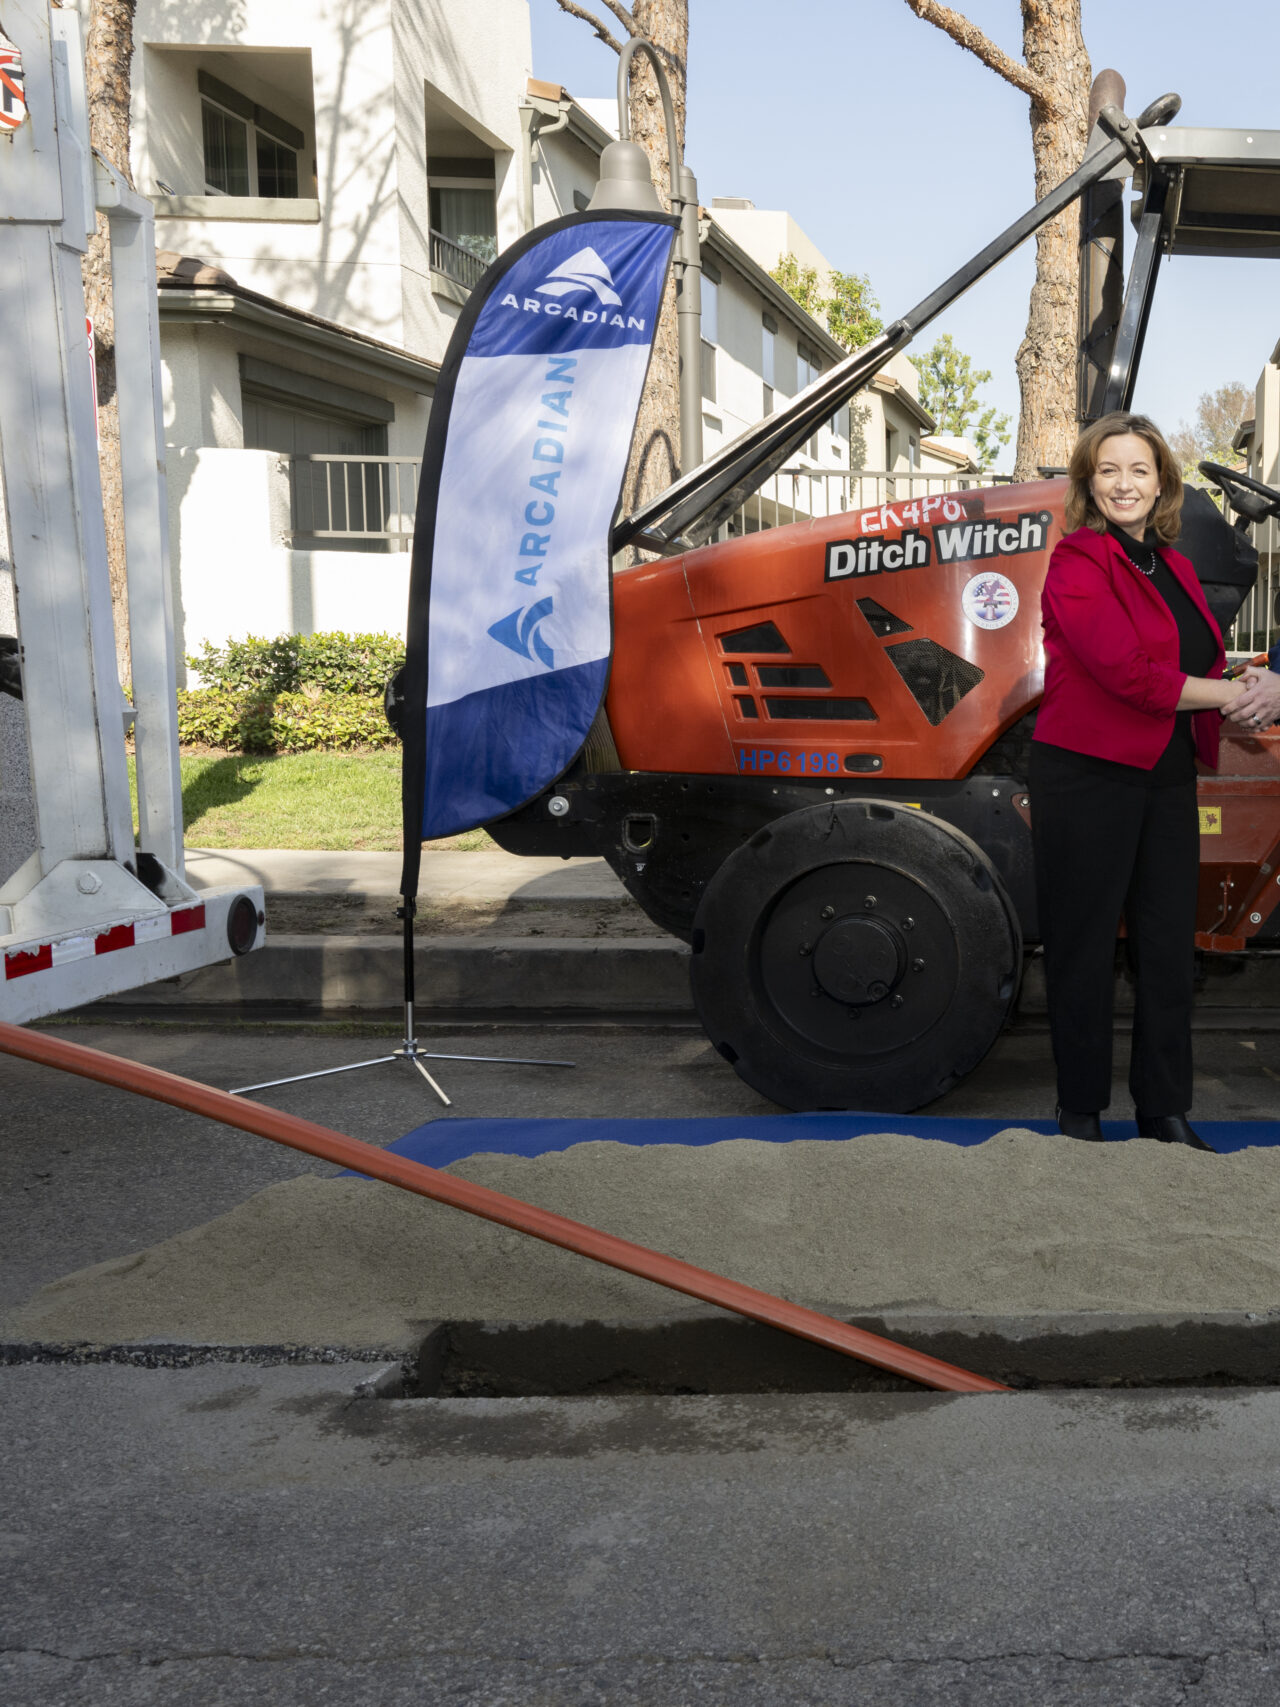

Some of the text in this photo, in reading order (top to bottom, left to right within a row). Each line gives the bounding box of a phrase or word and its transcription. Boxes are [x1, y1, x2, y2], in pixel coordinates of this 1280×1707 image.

[501, 293, 646, 332] ARCADIAN
[514, 357, 578, 587] ARCADIAN
[828, 534, 927, 578] Ditch
[740, 748, 840, 773] HP6198
